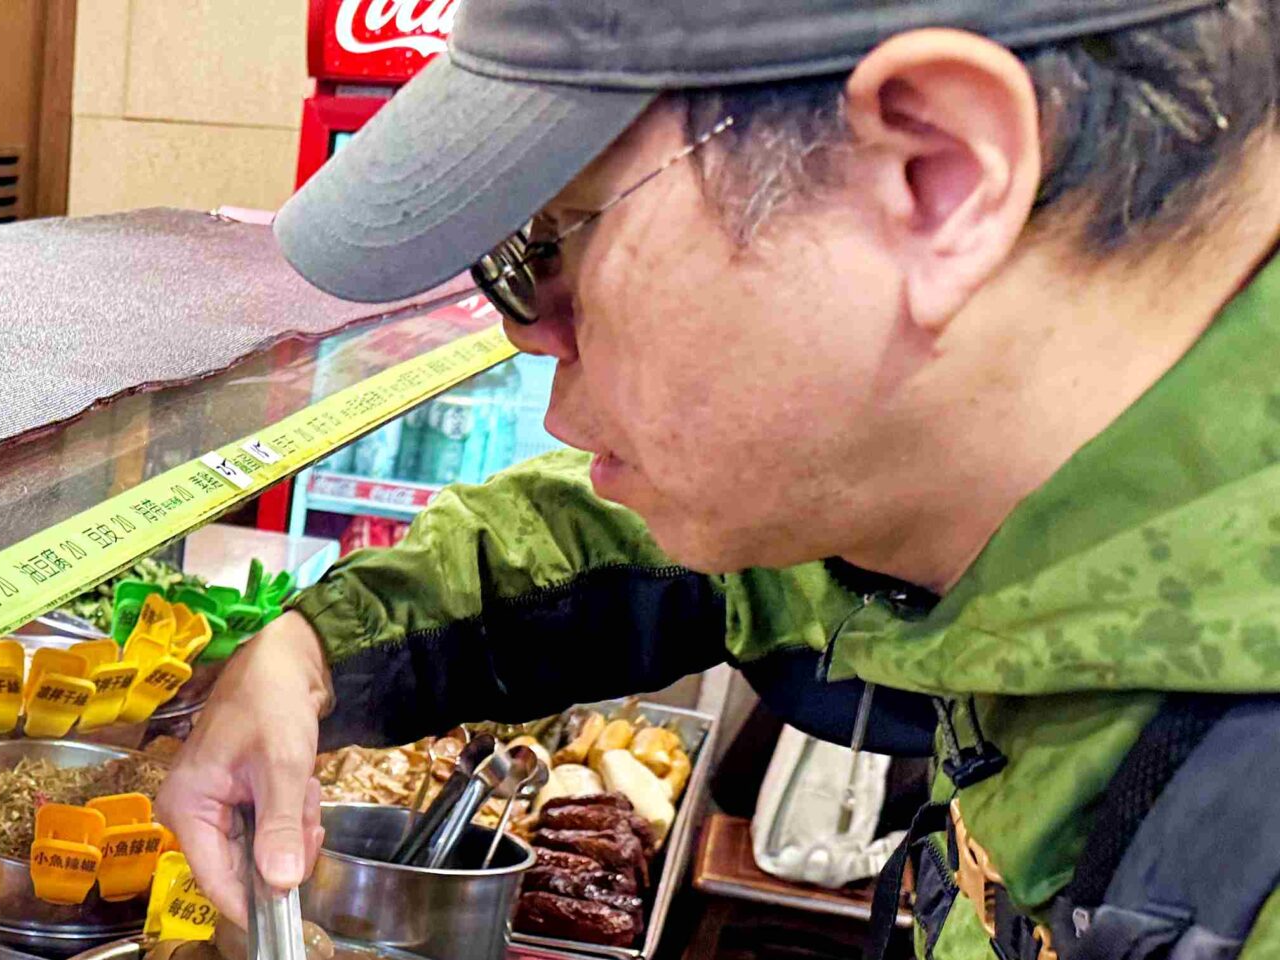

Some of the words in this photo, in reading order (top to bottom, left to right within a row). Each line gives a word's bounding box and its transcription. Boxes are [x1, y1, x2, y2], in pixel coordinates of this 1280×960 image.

[14, 548, 73, 586] 油豆腐
[60, 540, 87, 560] 20
[82, 523, 124, 549] 豆皮
[110, 514, 136, 533] 20
